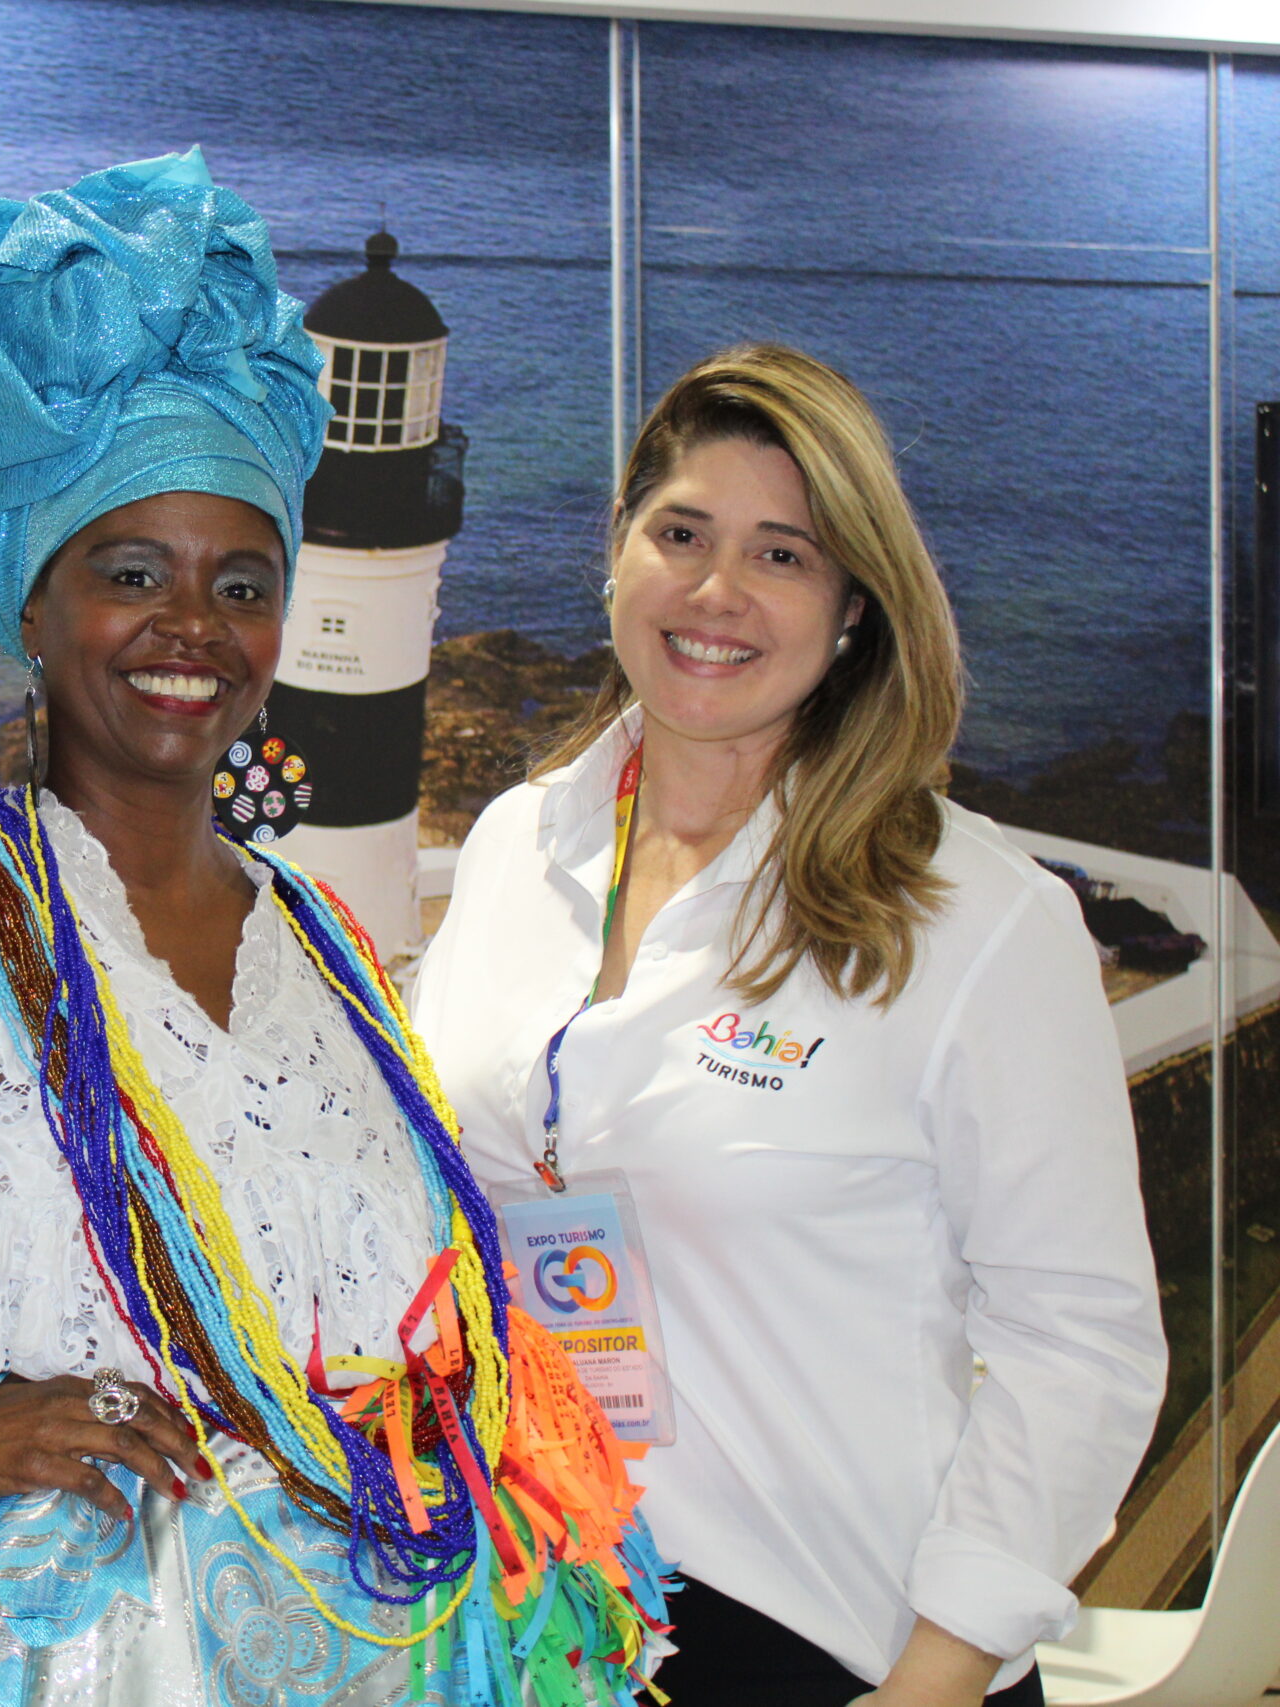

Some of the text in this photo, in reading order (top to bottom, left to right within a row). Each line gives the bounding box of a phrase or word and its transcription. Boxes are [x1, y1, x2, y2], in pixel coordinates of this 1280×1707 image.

[697, 1012, 825, 1068] Bahia!
[696, 1052, 783, 1091] TURISMO
[526, 1228, 606, 1247] EXPO TURISMO
[559, 1335, 638, 1353] POSITOR
[433, 1386, 460, 1444] BAHIA
